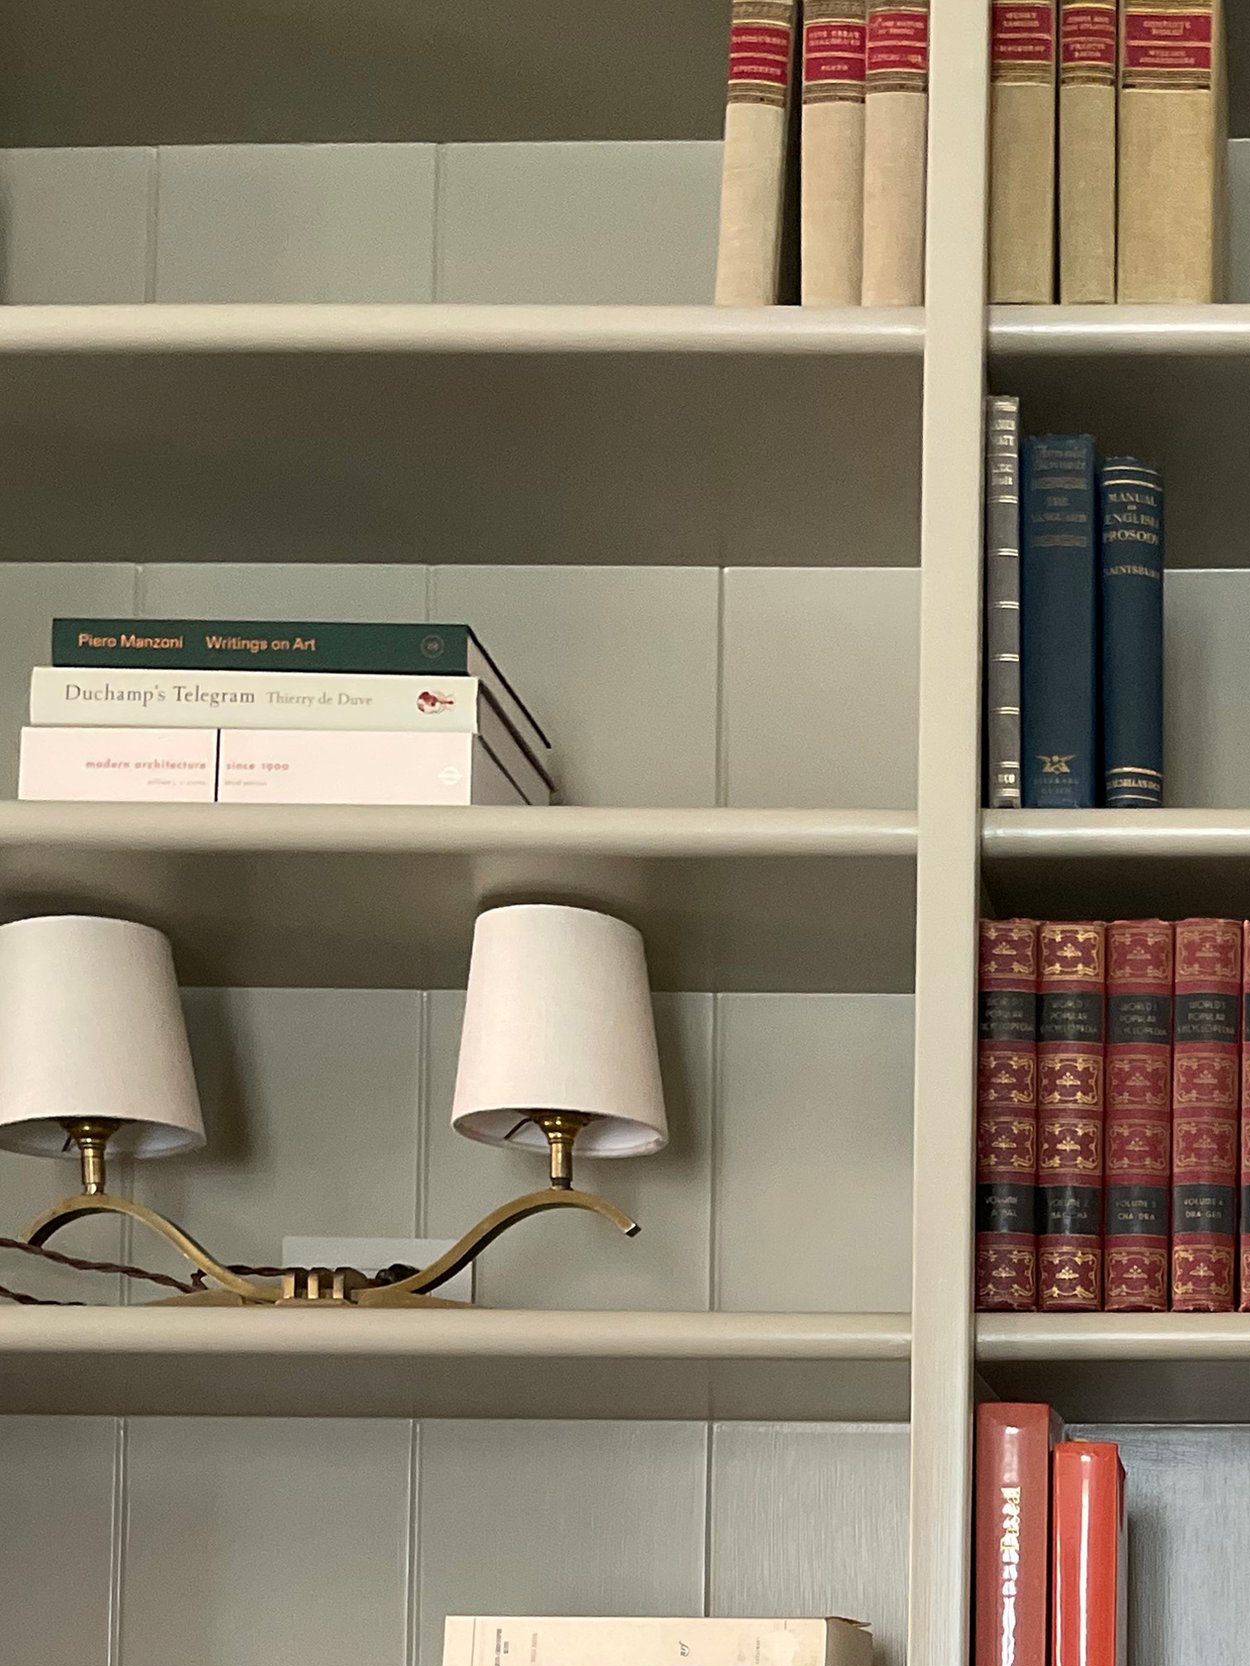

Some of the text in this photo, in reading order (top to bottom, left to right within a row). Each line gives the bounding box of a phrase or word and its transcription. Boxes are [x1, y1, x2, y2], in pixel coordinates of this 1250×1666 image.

[1107, 493, 1158, 507] MANUAL
[1105, 512, 1160, 529] ENGLISH
[78, 633, 184, 649] Piero Manzoni
[205, 635, 316, 652] Writings on Art
[64, 684, 256, 706] Duchamp's Telegram
[264, 690, 374, 707] Thierry de Duve
[85, 758, 207, 769] modern architecture
[225, 760, 290, 772] since 1900
